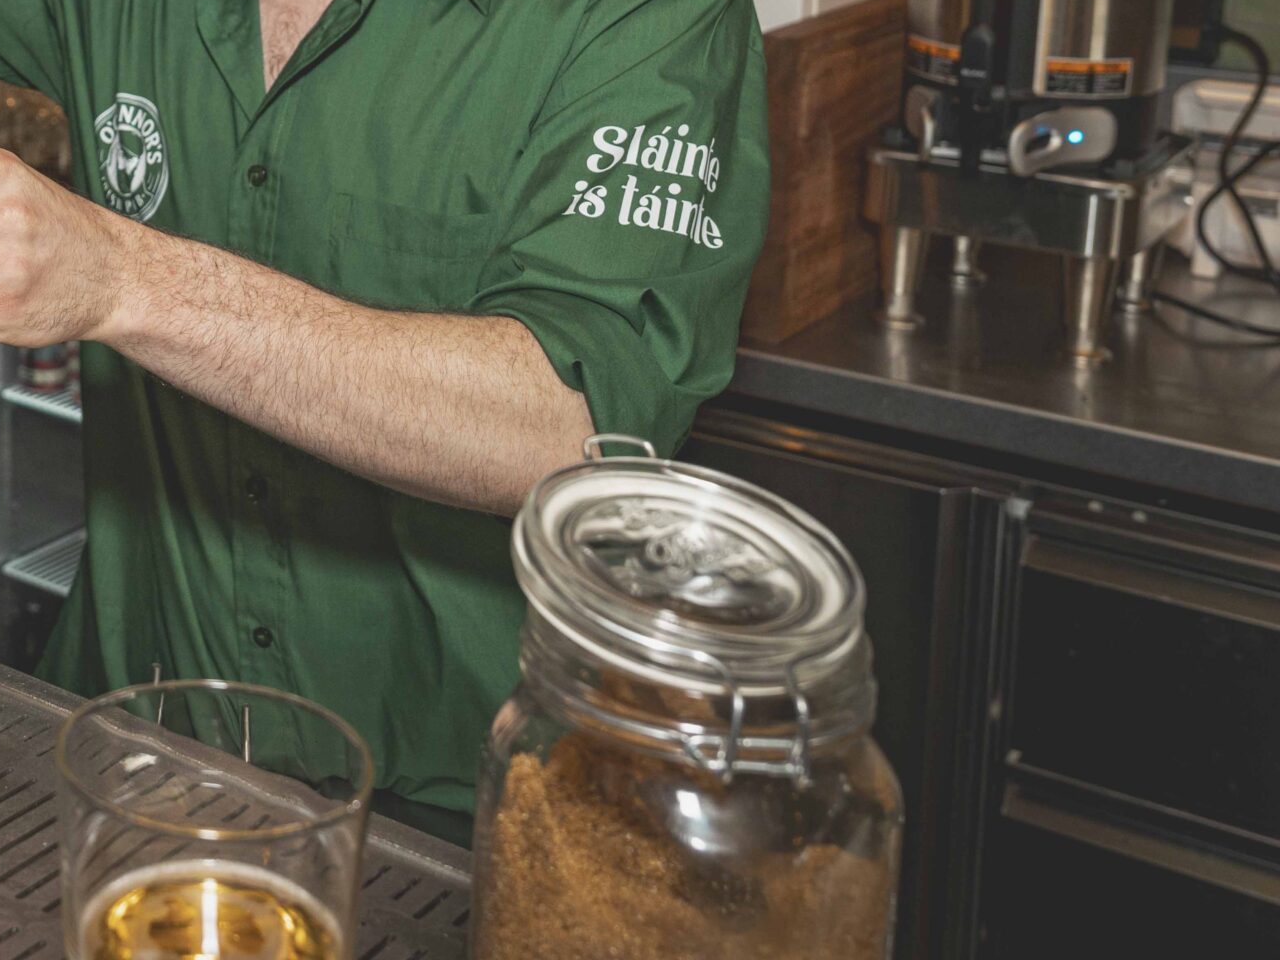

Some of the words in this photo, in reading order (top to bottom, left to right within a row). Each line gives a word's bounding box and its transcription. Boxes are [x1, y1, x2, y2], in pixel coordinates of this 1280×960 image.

[586, 124, 720, 193] Sláinte
[562, 180, 608, 218] is
[618, 174, 723, 249] táinte
